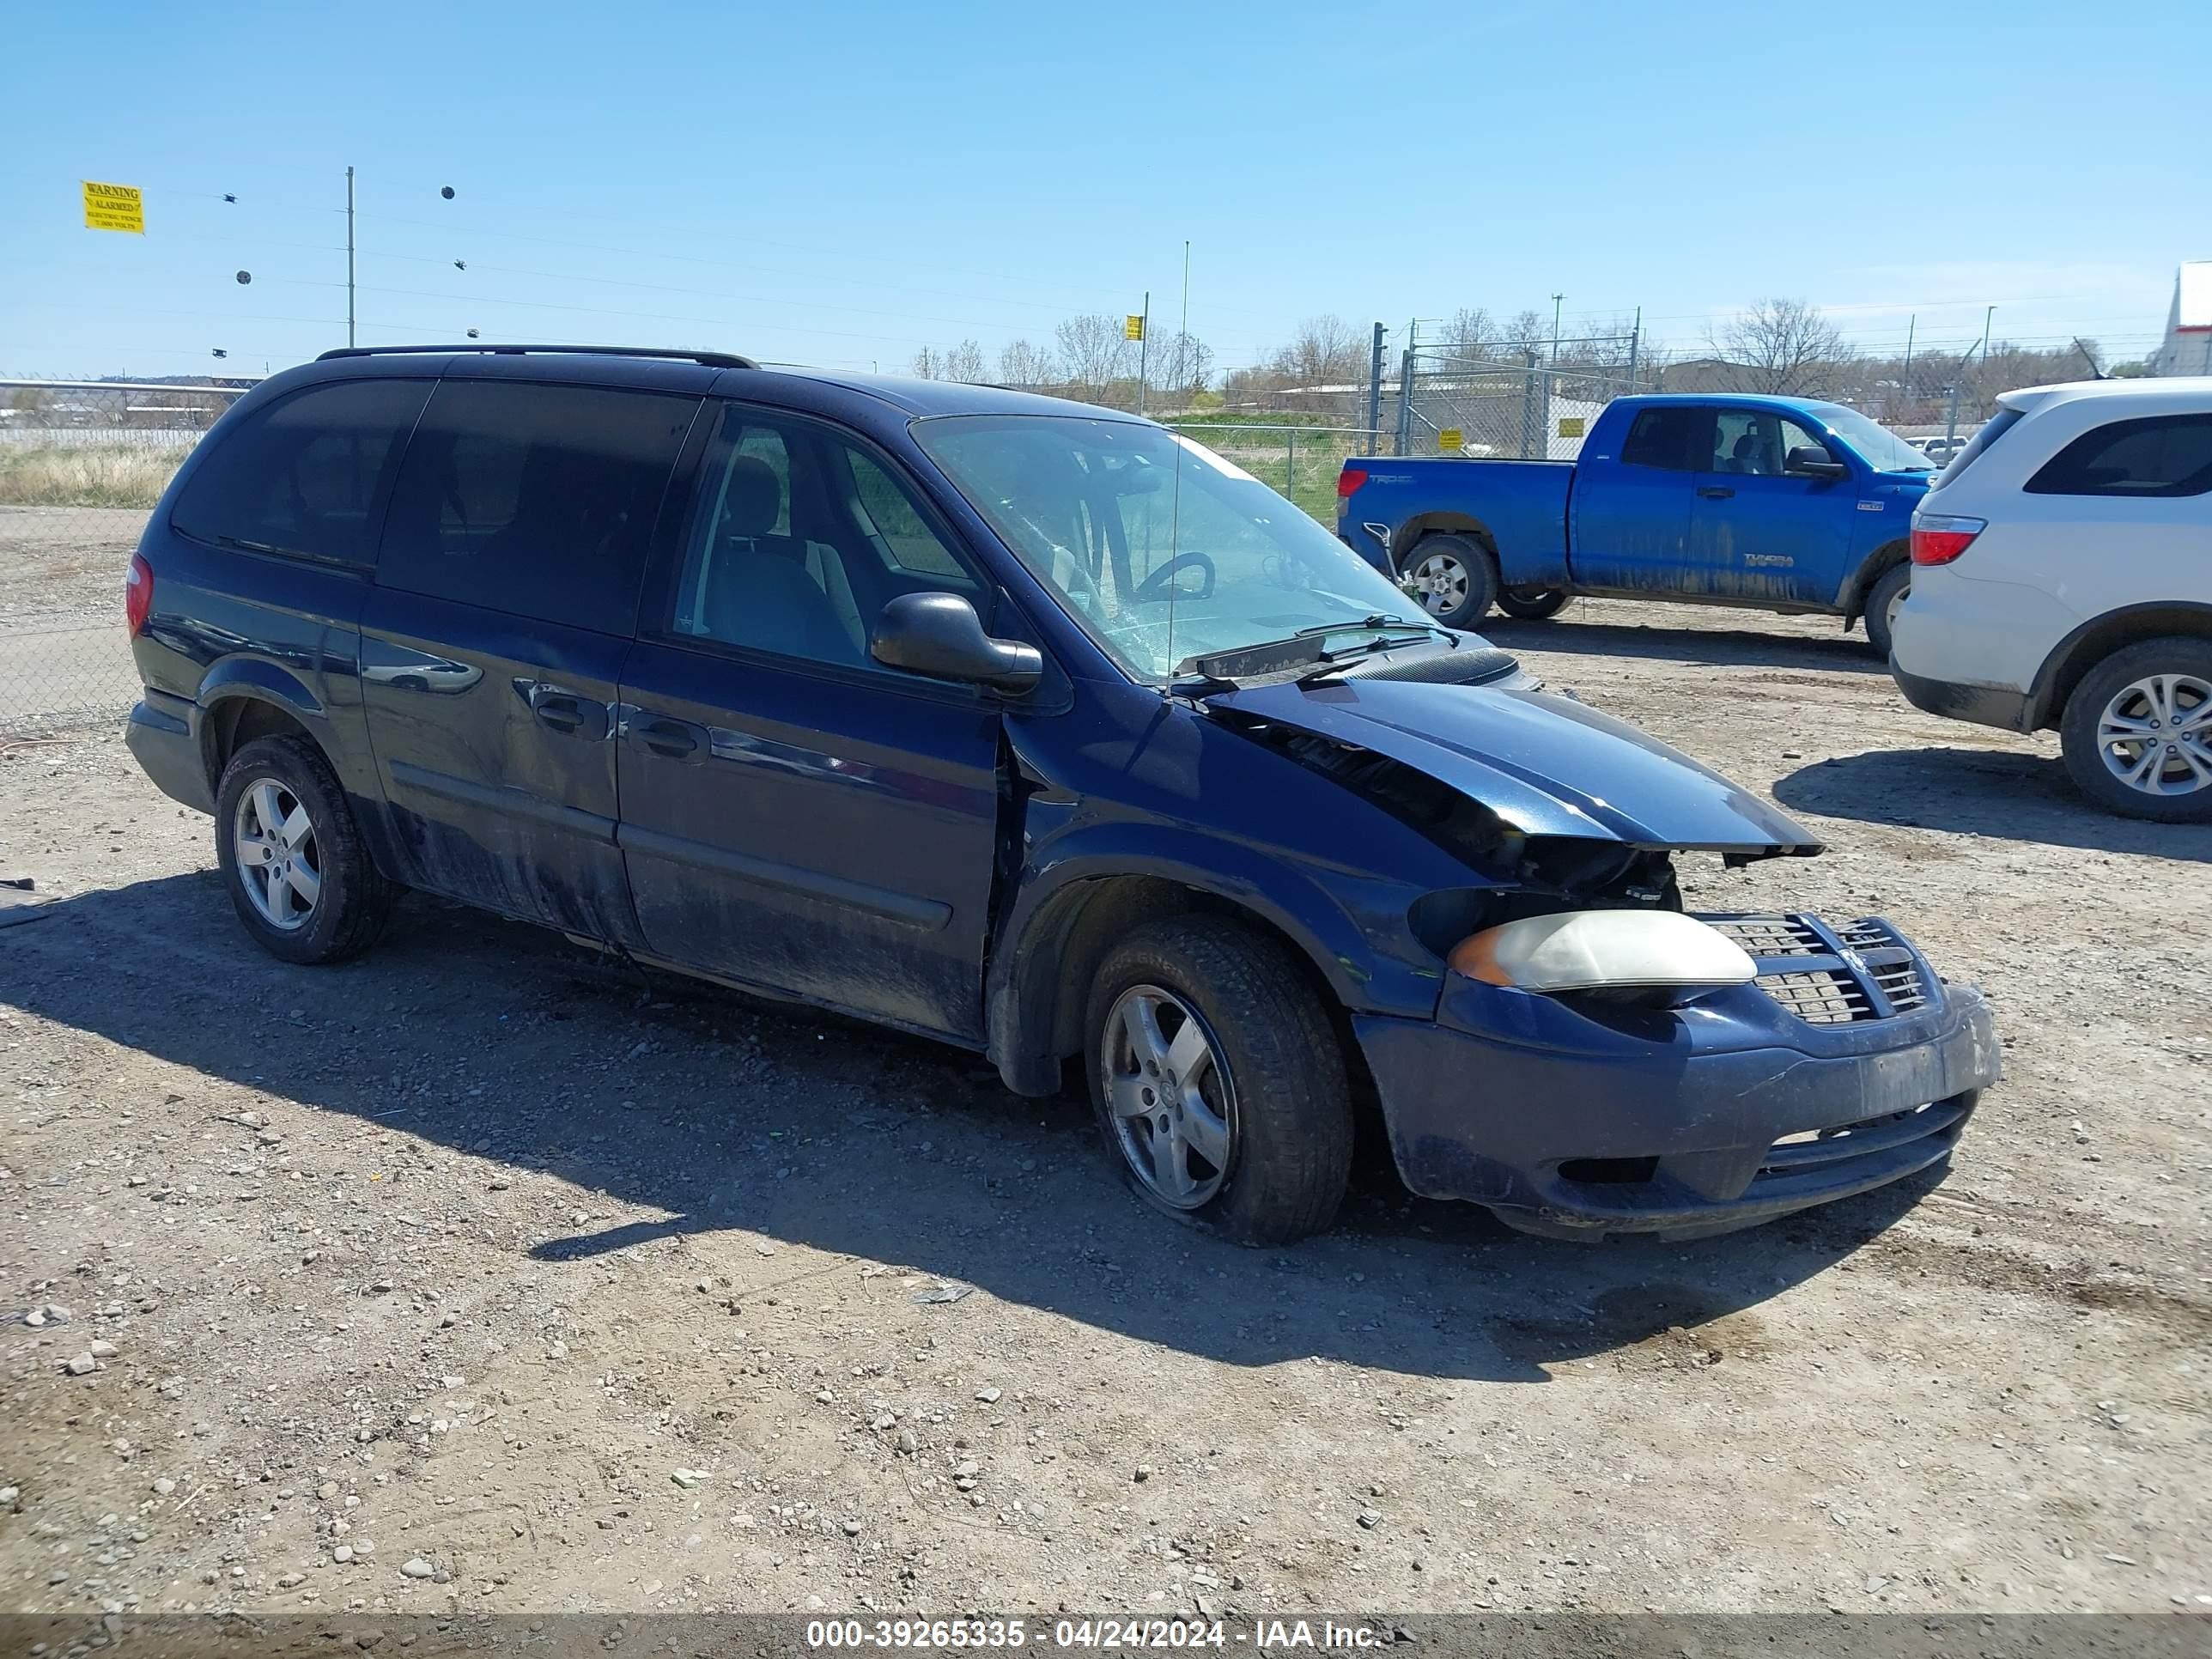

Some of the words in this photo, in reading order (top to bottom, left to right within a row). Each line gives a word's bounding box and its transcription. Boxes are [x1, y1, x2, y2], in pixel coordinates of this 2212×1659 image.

[86, 183, 138, 199] WARNING
[95, 200, 134, 212] ALARMED
[1744, 553, 1794, 564] TUNDRA
